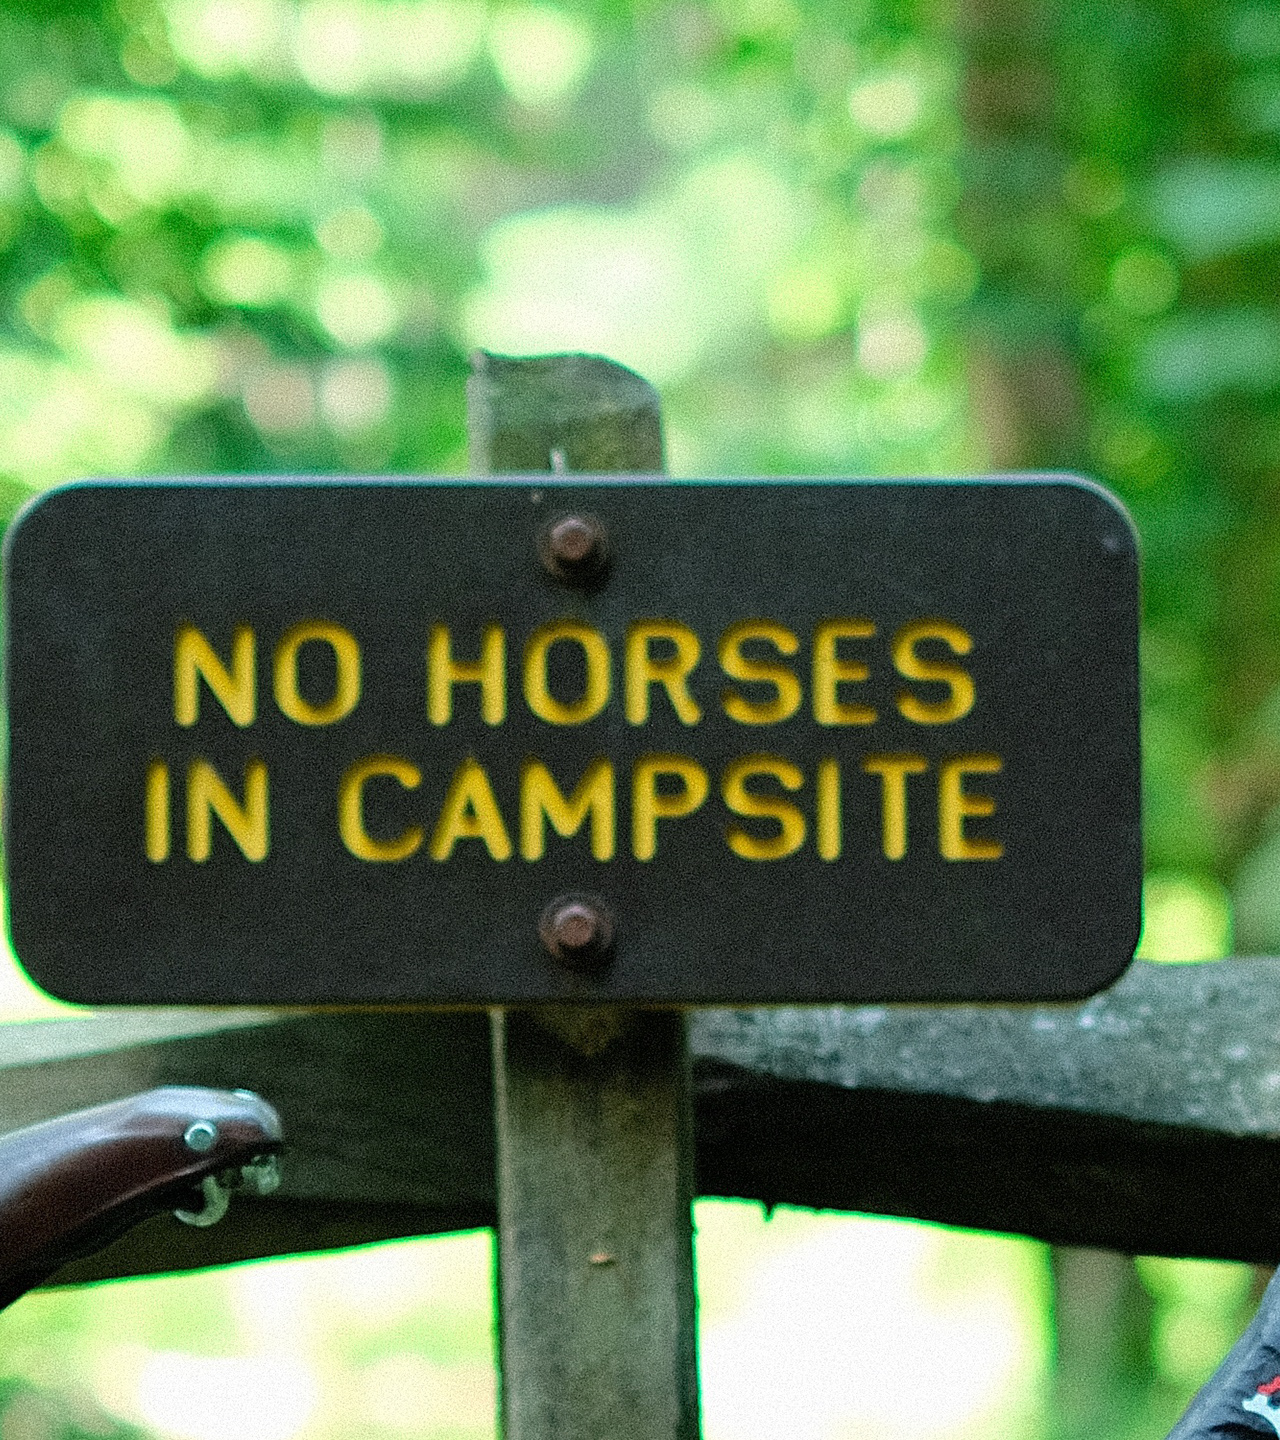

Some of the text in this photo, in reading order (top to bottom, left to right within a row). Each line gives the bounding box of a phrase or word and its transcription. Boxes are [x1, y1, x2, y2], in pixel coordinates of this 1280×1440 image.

[173, 618, 976, 728] NO HORSES
[144, 752, 1006, 864] IN CAMPSITE
